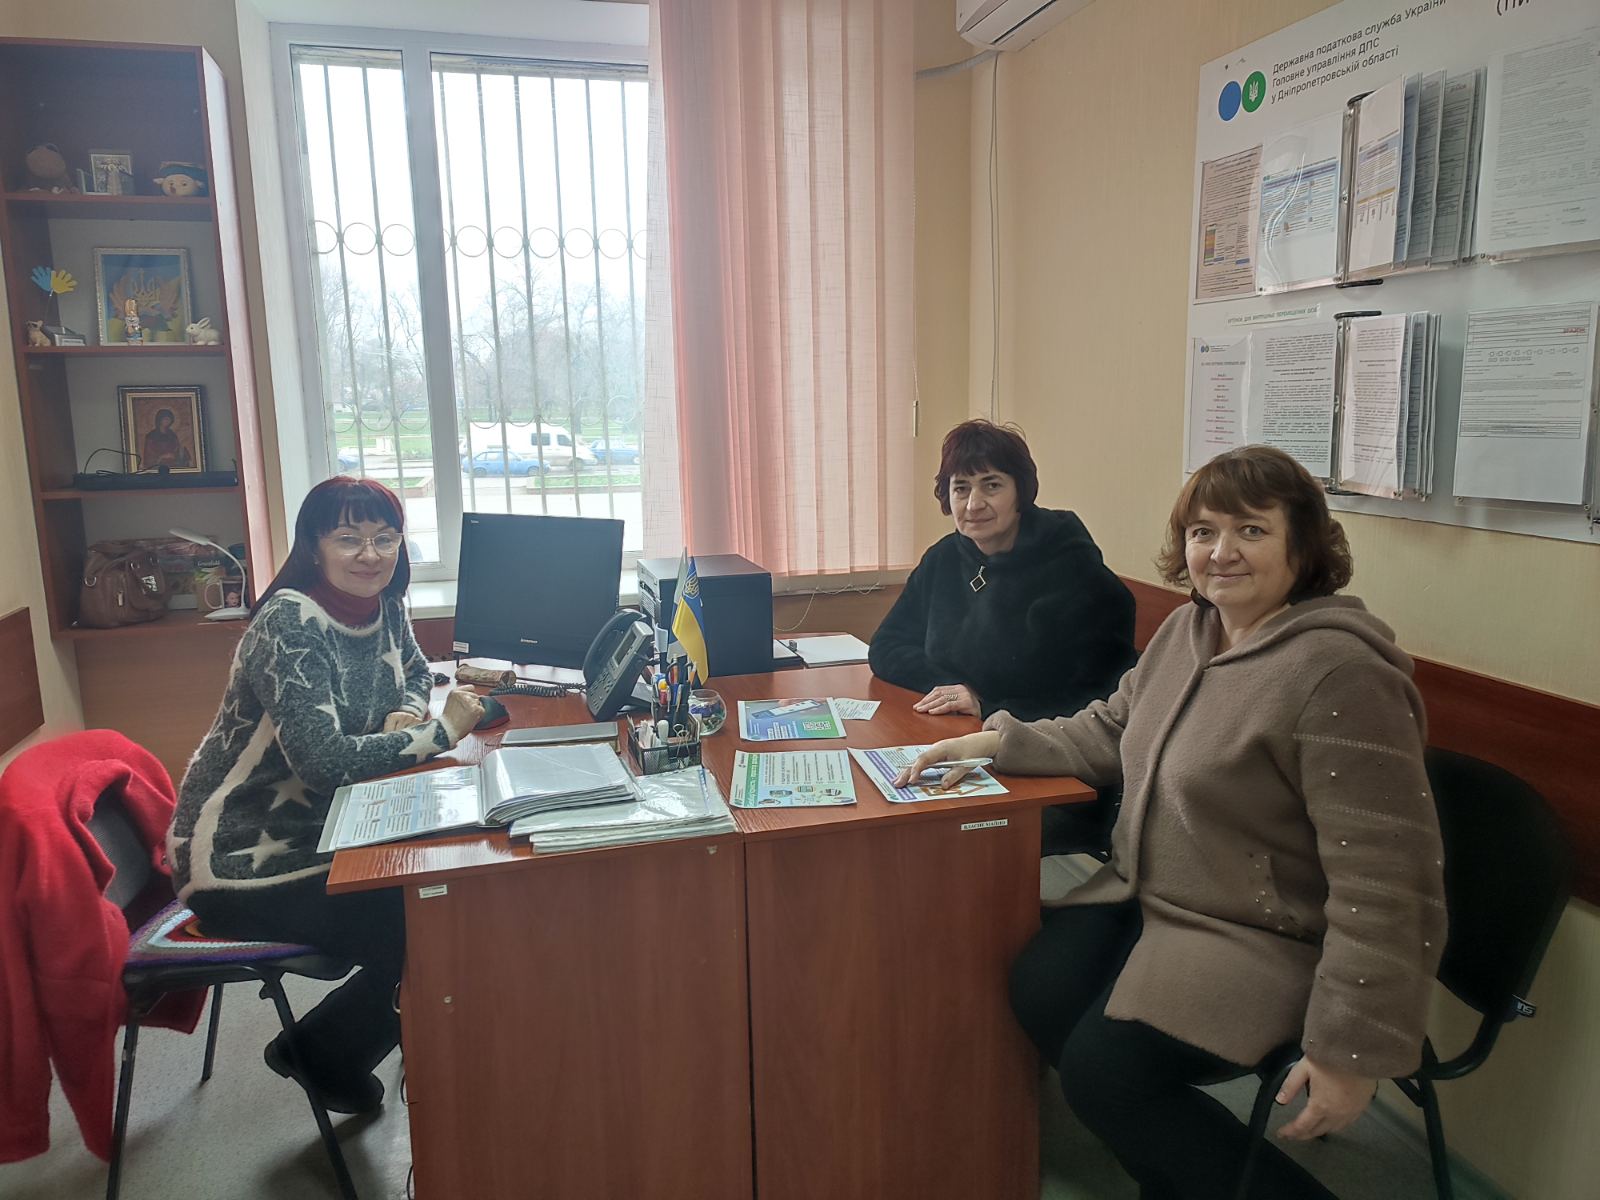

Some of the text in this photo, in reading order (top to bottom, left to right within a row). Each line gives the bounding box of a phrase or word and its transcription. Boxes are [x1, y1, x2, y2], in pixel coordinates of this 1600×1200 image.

[1272, 37, 1380, 88] Головне управління ДПС
[1273, 51, 1314, 75] Державна
[1316, 30, 1363, 57] податкова
[1364, 13, 1402, 36] служба
[1271, 45, 1400, 105] у Дніпропетровській області
